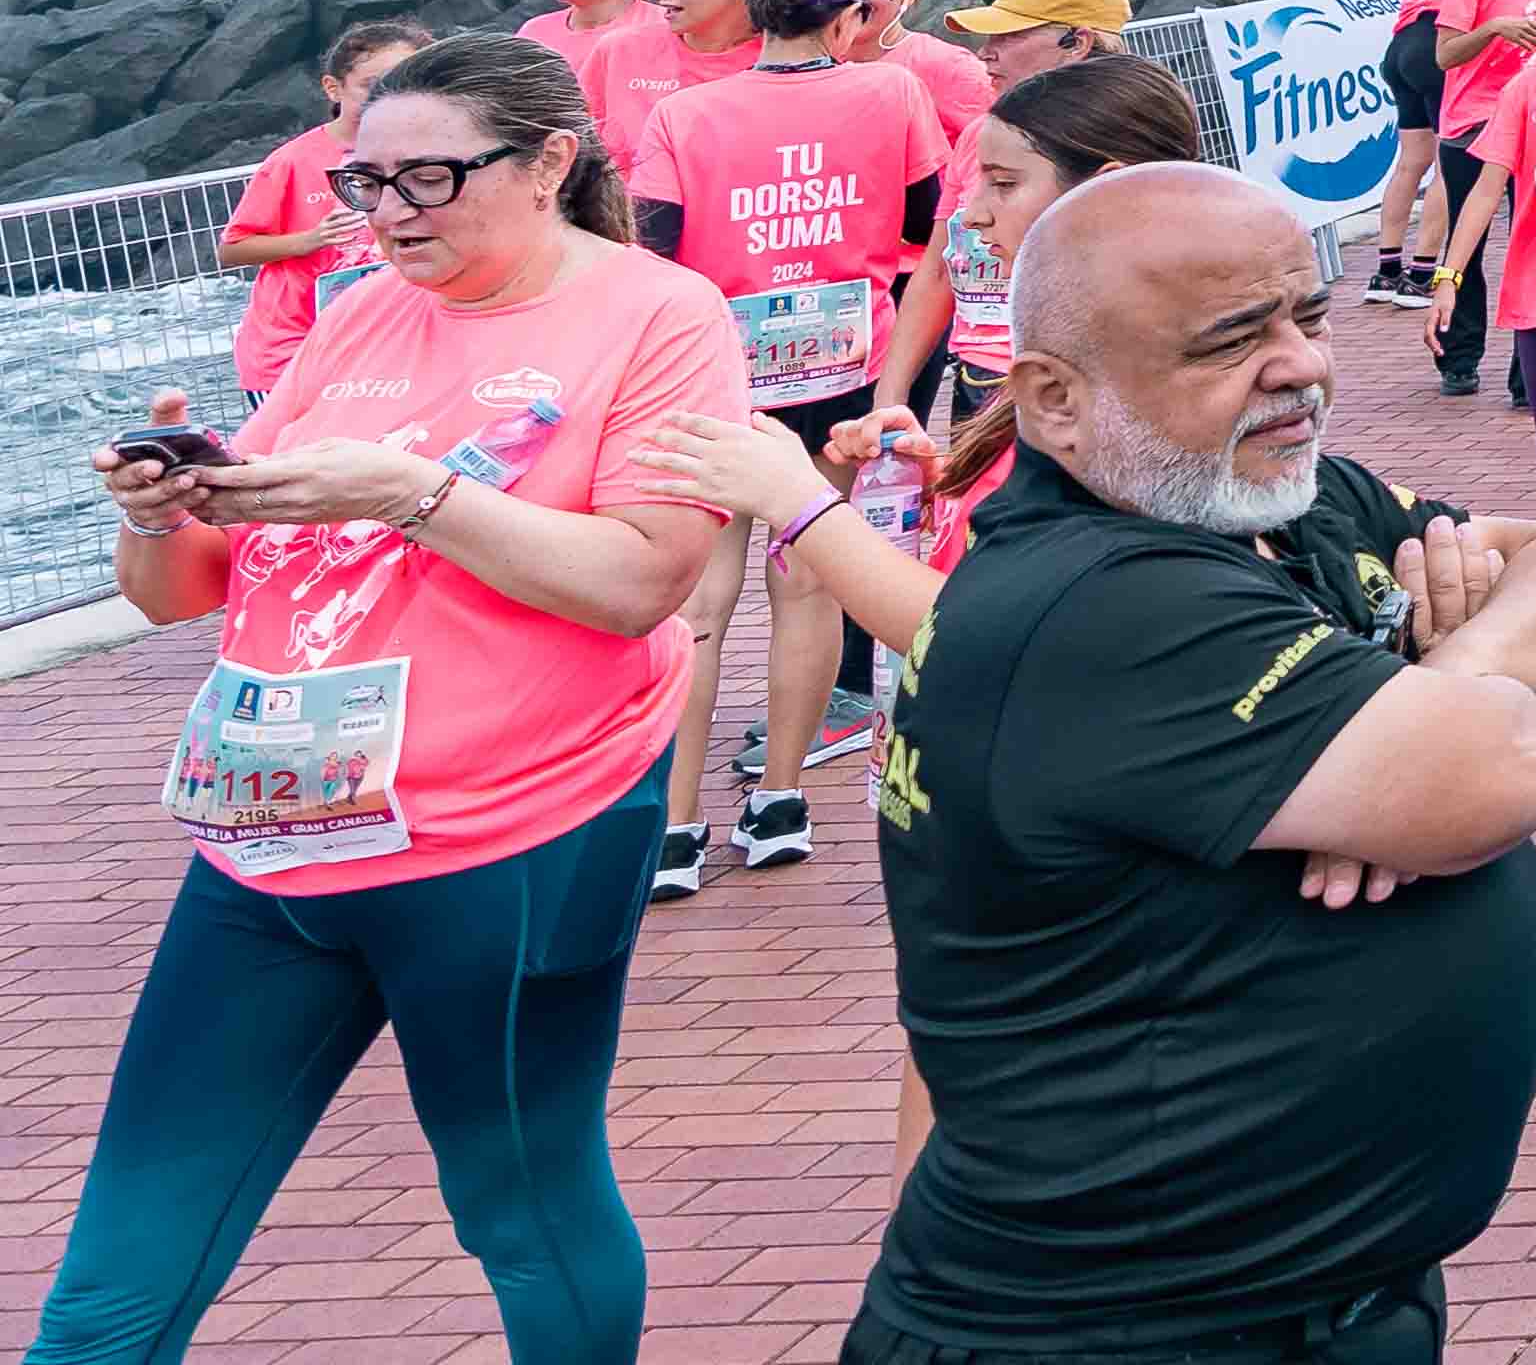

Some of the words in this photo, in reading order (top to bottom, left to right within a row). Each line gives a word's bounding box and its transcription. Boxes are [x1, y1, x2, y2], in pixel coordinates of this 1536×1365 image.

[776, 142, 823, 178] TU
[730, 173, 865, 222] DORSAL
[747, 211, 844, 256] SUMA
[772, 261, 814, 283] 2024
[976, 261, 1009, 280] 11
[765, 338, 820, 362] 112
[320, 378, 412, 401] OYSHO
[221, 770, 300, 802] 112
[233, 808, 279, 824] 2195
[237, 827, 281, 839] MUJER
[291, 822, 325, 835] GRAN
[327, 813, 386, 830] CANARIA
